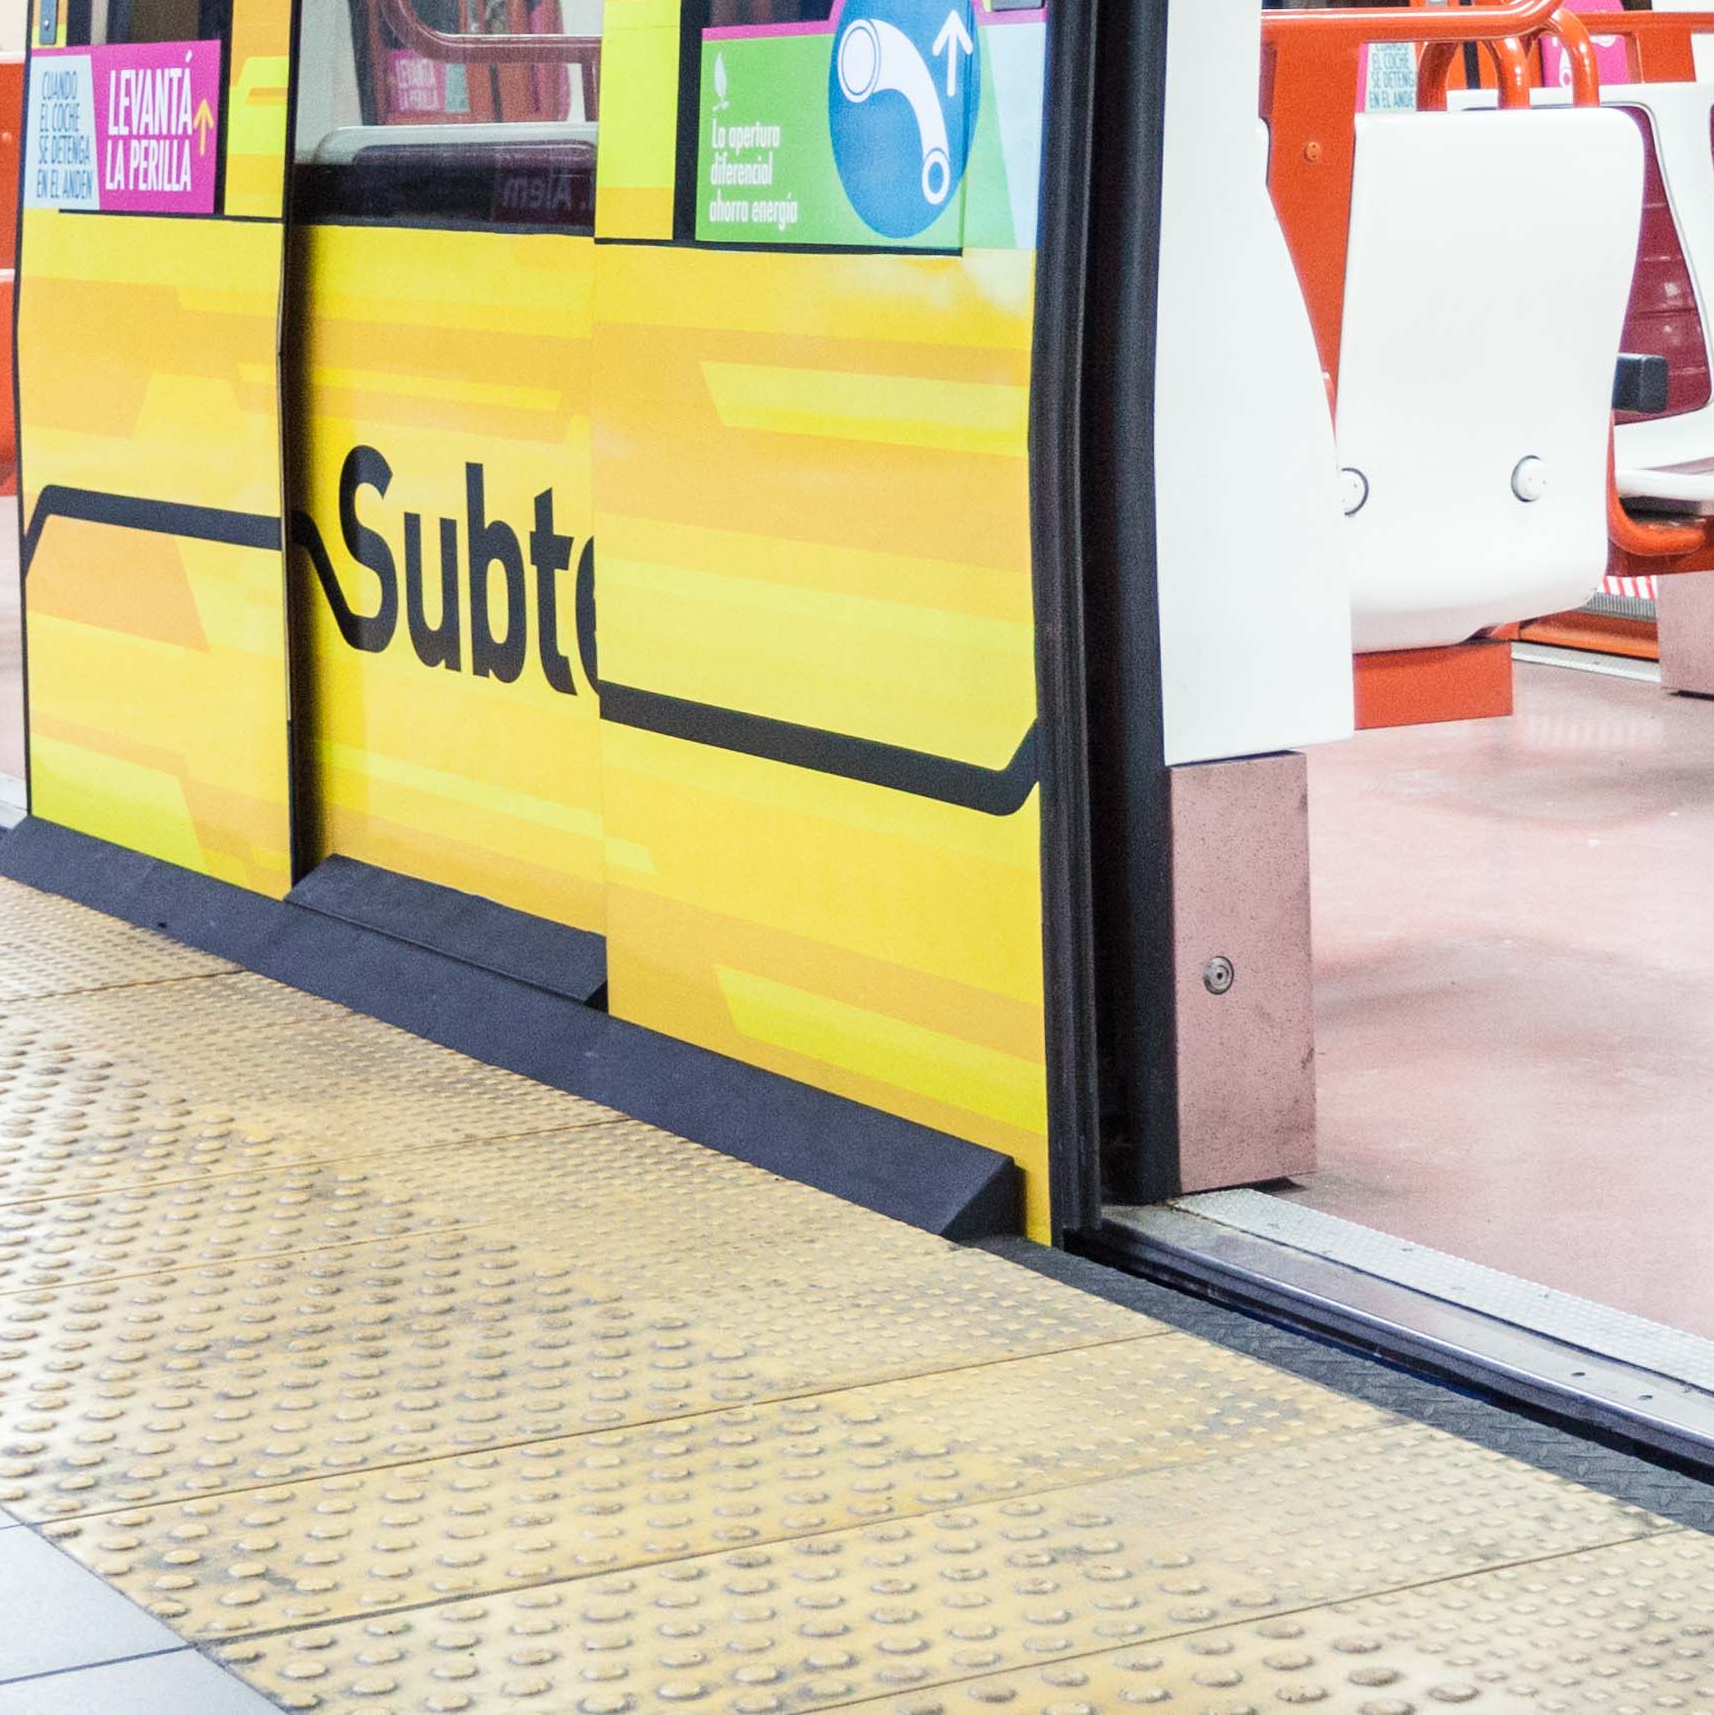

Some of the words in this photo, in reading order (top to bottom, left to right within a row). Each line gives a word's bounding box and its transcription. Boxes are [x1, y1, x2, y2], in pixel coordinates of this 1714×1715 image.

[43, 70, 78, 100] CUANDO
[108, 50, 193, 136] LEVANTÁ
[40, 103, 50, 132] EL
[52, 103, 81, 132] COCHE
[39, 135, 49, 165] SE
[51, 135, 91, 165] DETENGA
[712, 118, 726, 148] La
[728, 120, 781, 157] apertura
[37, 169, 48, 198] EN
[50, 169, 60, 198] EL
[105, 140, 125, 190] LA
[129, 139, 193, 192] PERILLA
[711, 150, 774, 186] diferencial
[709, 188, 750, 223] ahorra
[751, 192, 798, 231] energía
